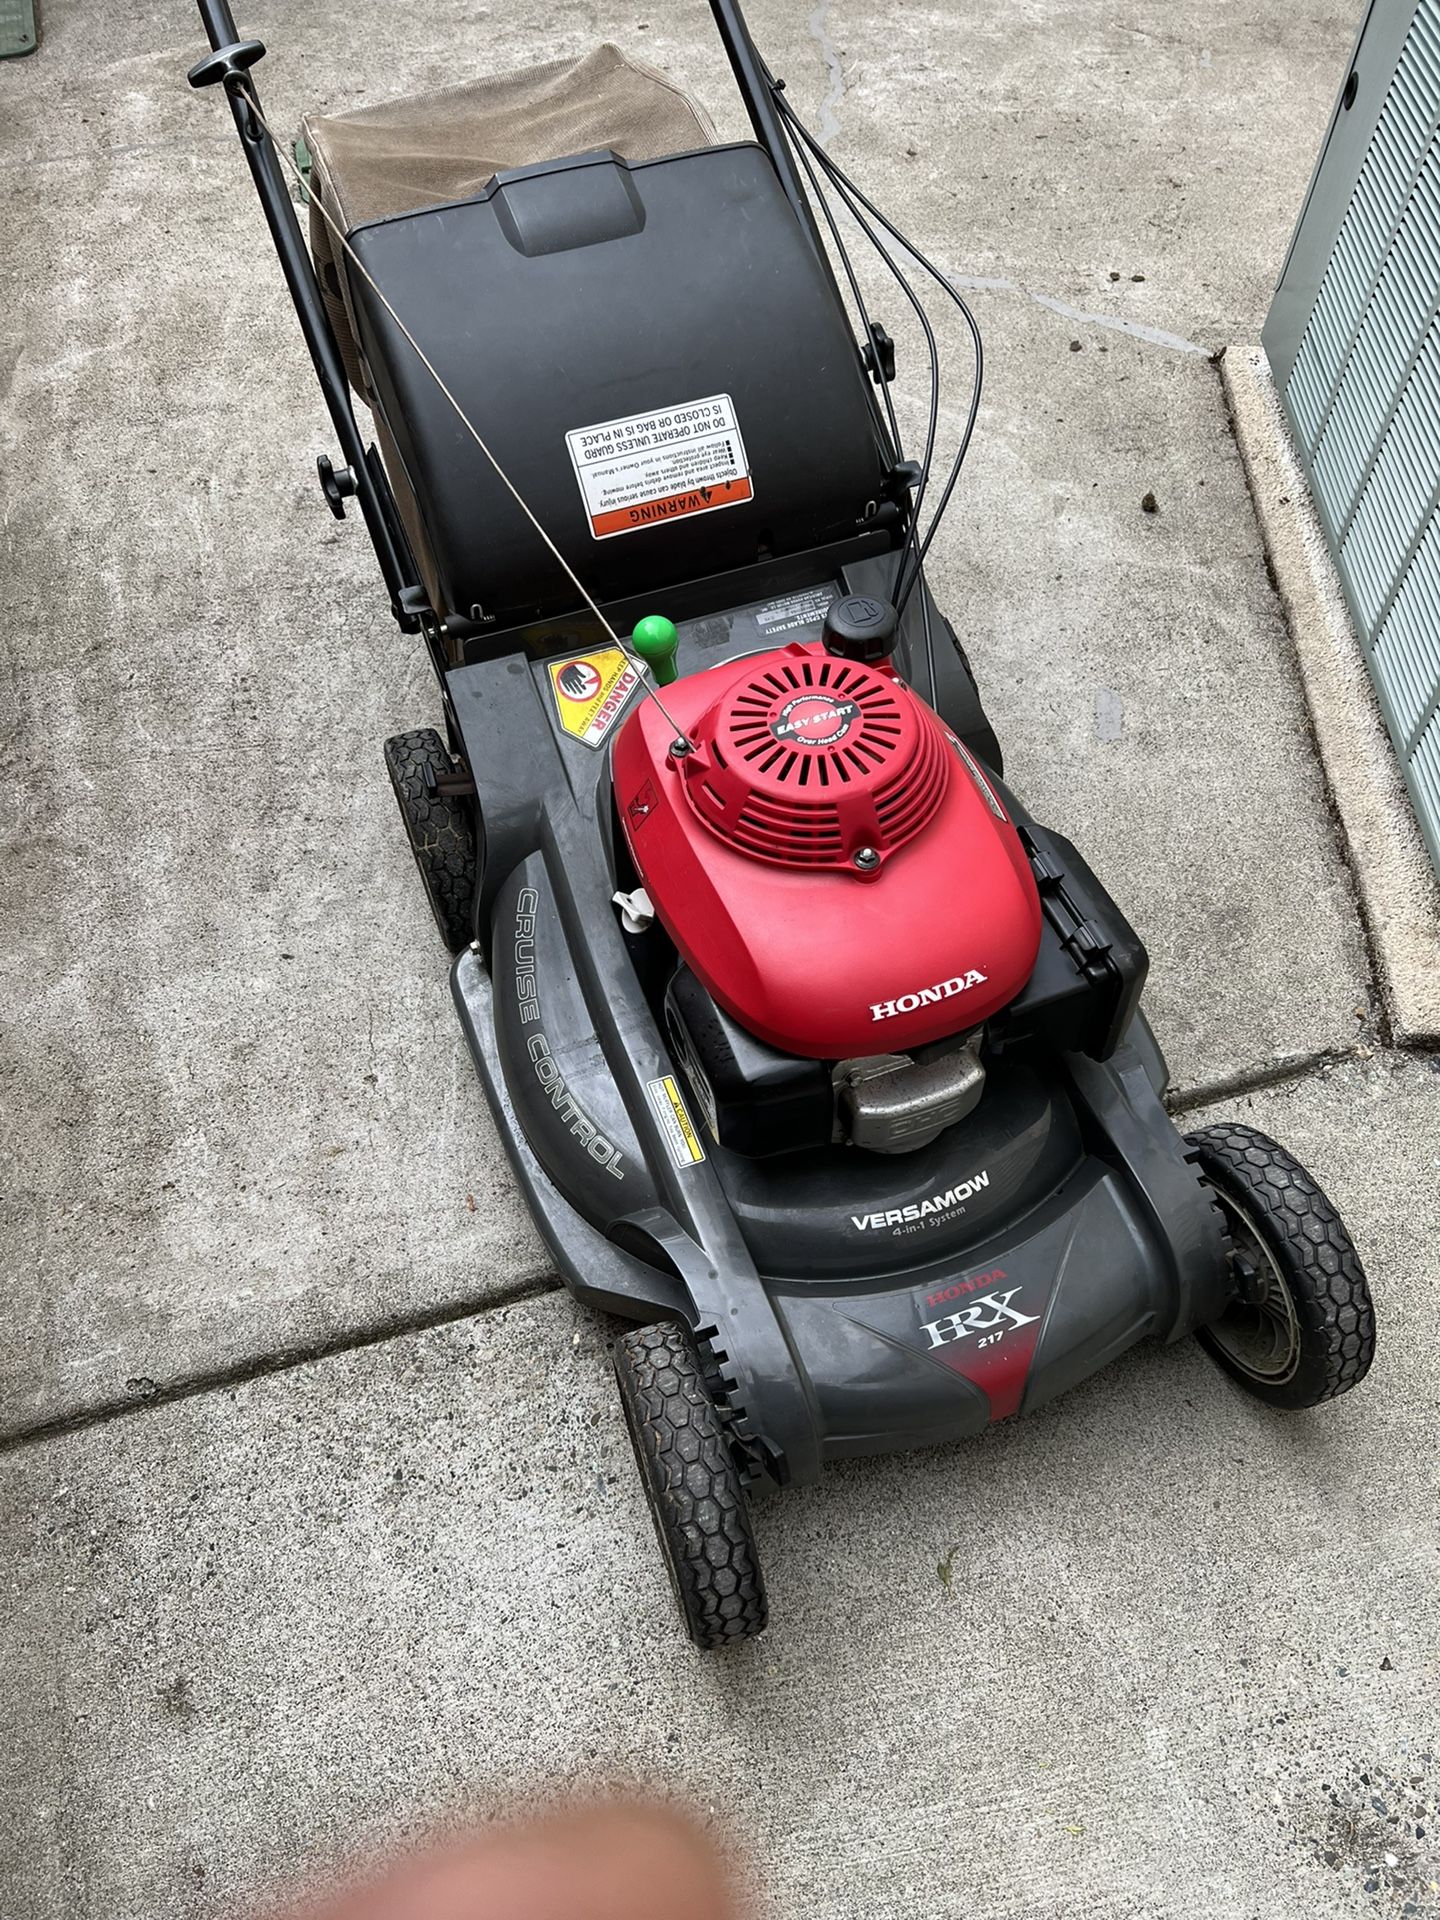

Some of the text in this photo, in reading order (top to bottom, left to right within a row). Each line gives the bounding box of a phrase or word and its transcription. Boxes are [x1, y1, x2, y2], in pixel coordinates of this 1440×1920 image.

[580, 404, 721, 446] IS CLOSED OR BAG IS IN PLACE
[584, 417, 724, 459] DO NOT OPERATE UNLESS GUARD
[706, 440, 724, 449] Follow
[662, 447, 696, 460] instructions
[712, 447, 725, 455] Wear
[713, 453, 726, 461] Keep
[615, 462, 639, 472] Owner's
[640, 458, 653, 466] your
[690, 457, 712, 467] children
[709, 460, 728, 469] Inspect
[661, 466, 677, 474] others
[662, 471, 683, 480] remove
[716, 468, 737, 479] Objects
[644, 476, 661, 485] debris
[687, 478, 694, 486] by
[695, 473, 714, 484] thrown
[625, 481, 642, 490] before
[657, 485, 668, 493] can
[670, 480, 685, 490] blade
[617, 492, 638, 503] serious
[639, 488, 656, 498] cause
[629, 494, 699, 521] WARNING
[765, 624, 785, 633] SAFETY
[787, 619, 804, 627] BLADE
[603, 671, 618, 691] HANDS
[592, 671, 635, 731] DANGER
[782, 695, 833, 716] High Performance
[587, 702, 598, 716] FEET
[577, 717, 589, 733] AWAY
[776, 704, 852, 734] EASY START
[796, 723, 848, 744] Over Head Cam
[870, 969, 988, 1021] HONDA
[514, 887, 625, 1180] CRUISE CONTROL
[661, 1093, 672, 1112] MUFFLER
[676, 1108, 692, 1137] CAUTION
[851, 1170, 990, 1231] VERSAMOW
[892, 1205, 966, 1237] 4-in-1 System
[926, 1268, 1008, 1308] HONDA
[919, 1286, 1041, 1350] HRX
[977, 1331, 1004, 1349] 217
